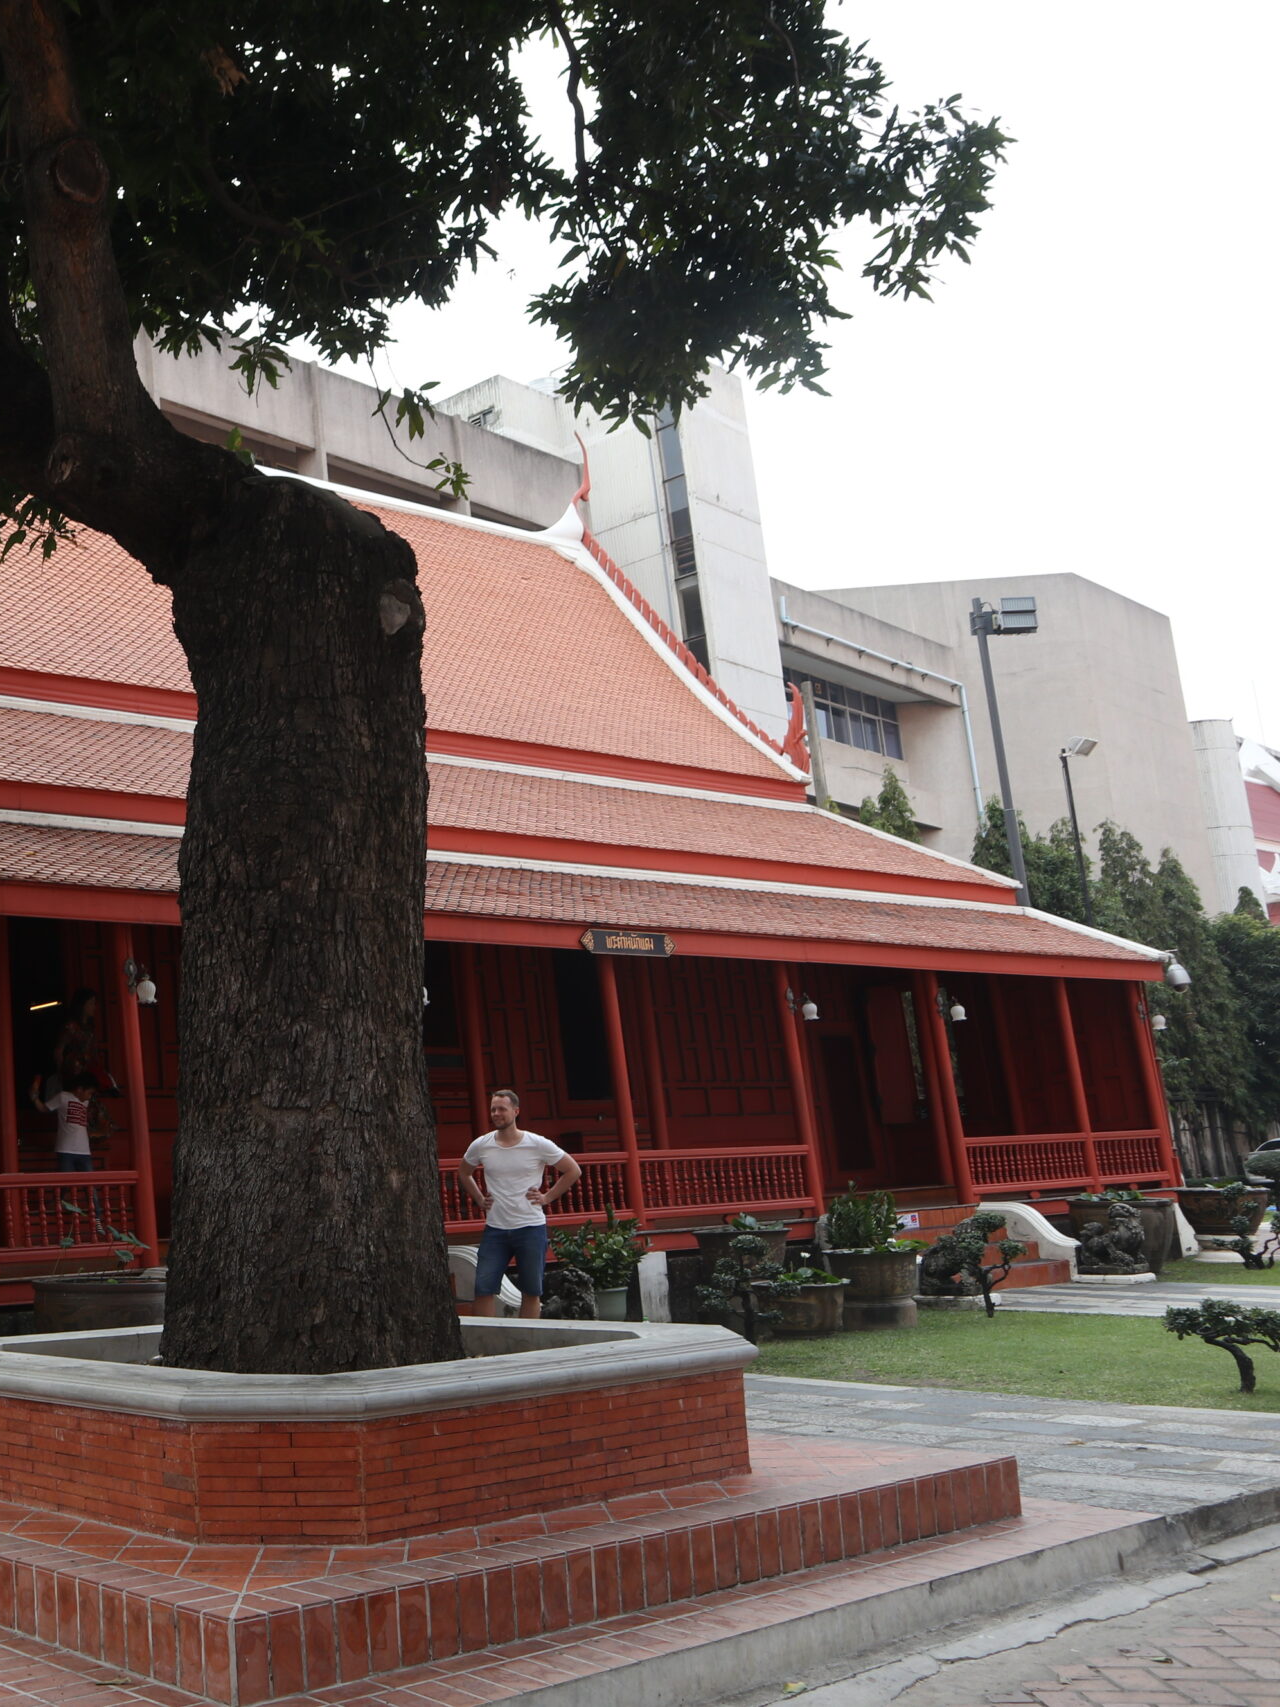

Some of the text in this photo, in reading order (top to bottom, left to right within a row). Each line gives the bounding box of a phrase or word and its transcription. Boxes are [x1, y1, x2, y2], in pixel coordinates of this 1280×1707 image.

[605, 932, 654, 951] พระตำหนักแดง
